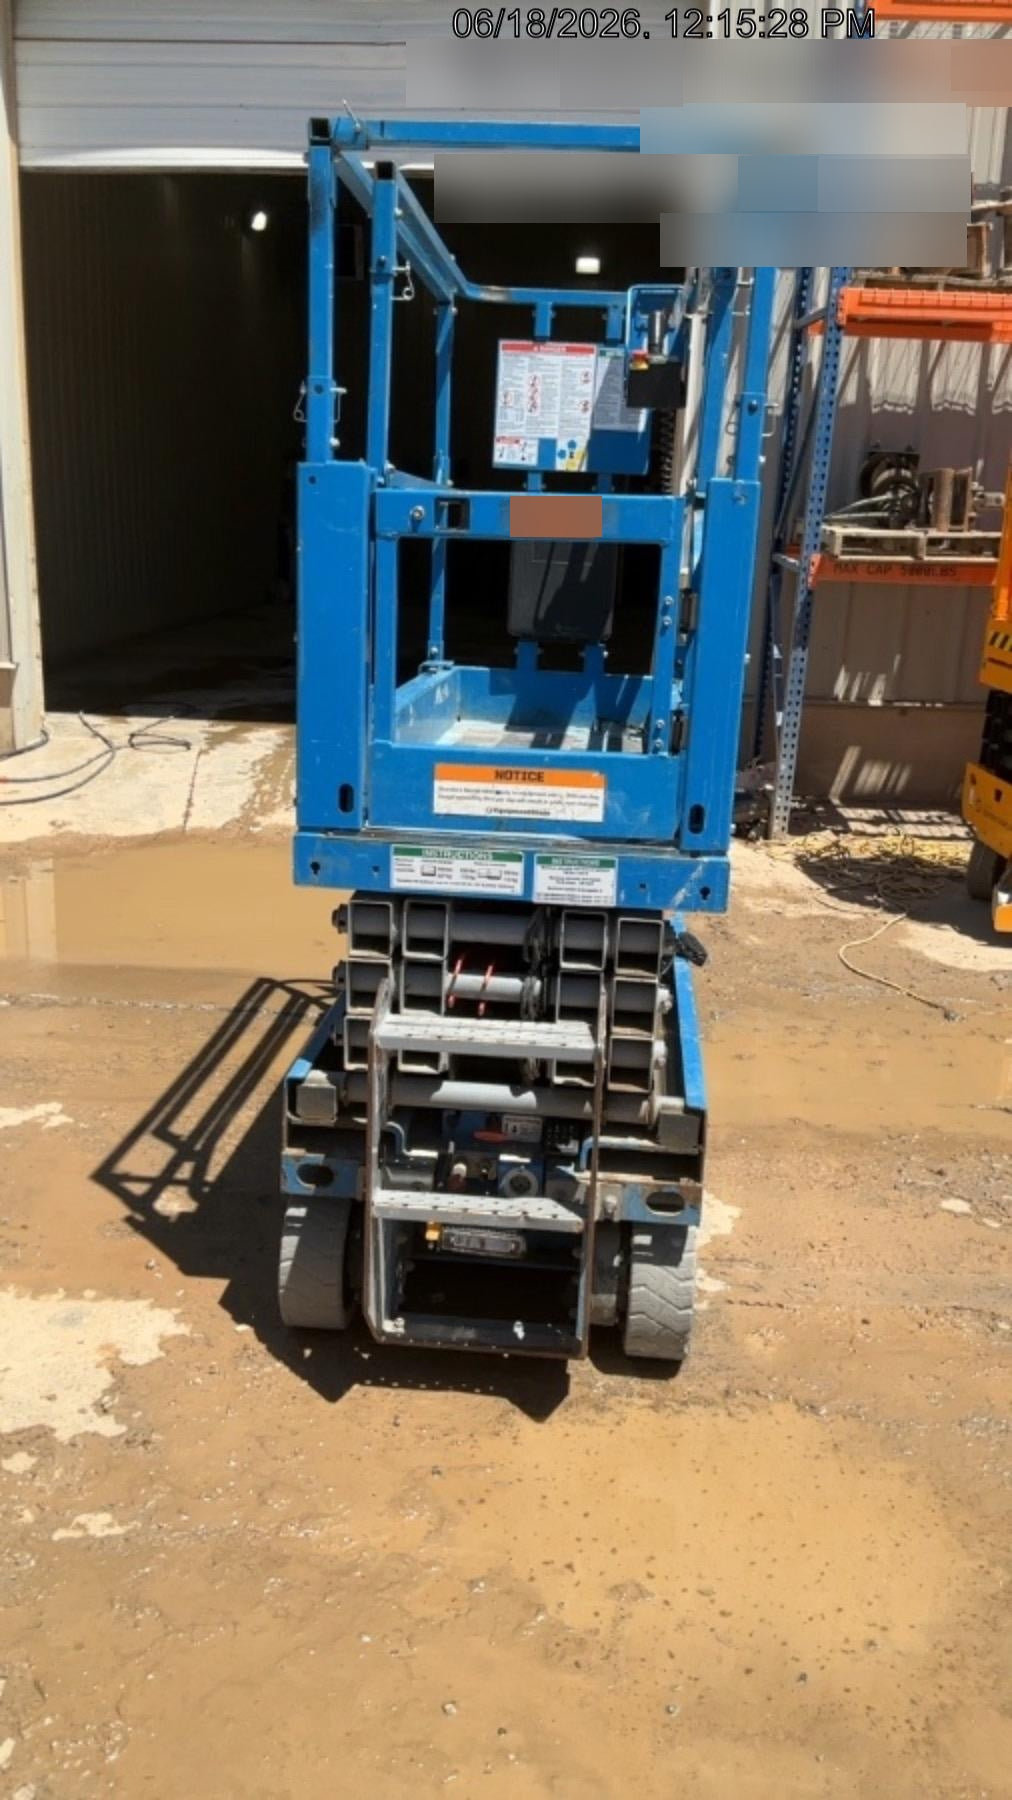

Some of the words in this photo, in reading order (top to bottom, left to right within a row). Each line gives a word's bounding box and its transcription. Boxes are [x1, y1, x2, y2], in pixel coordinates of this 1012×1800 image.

[833, 563, 858, 575] MAX
[866, 563, 892, 576] CAP
[494, 768, 545, 783] NOTICE
[422, 848, 493, 861] INSTRUCTIONS
